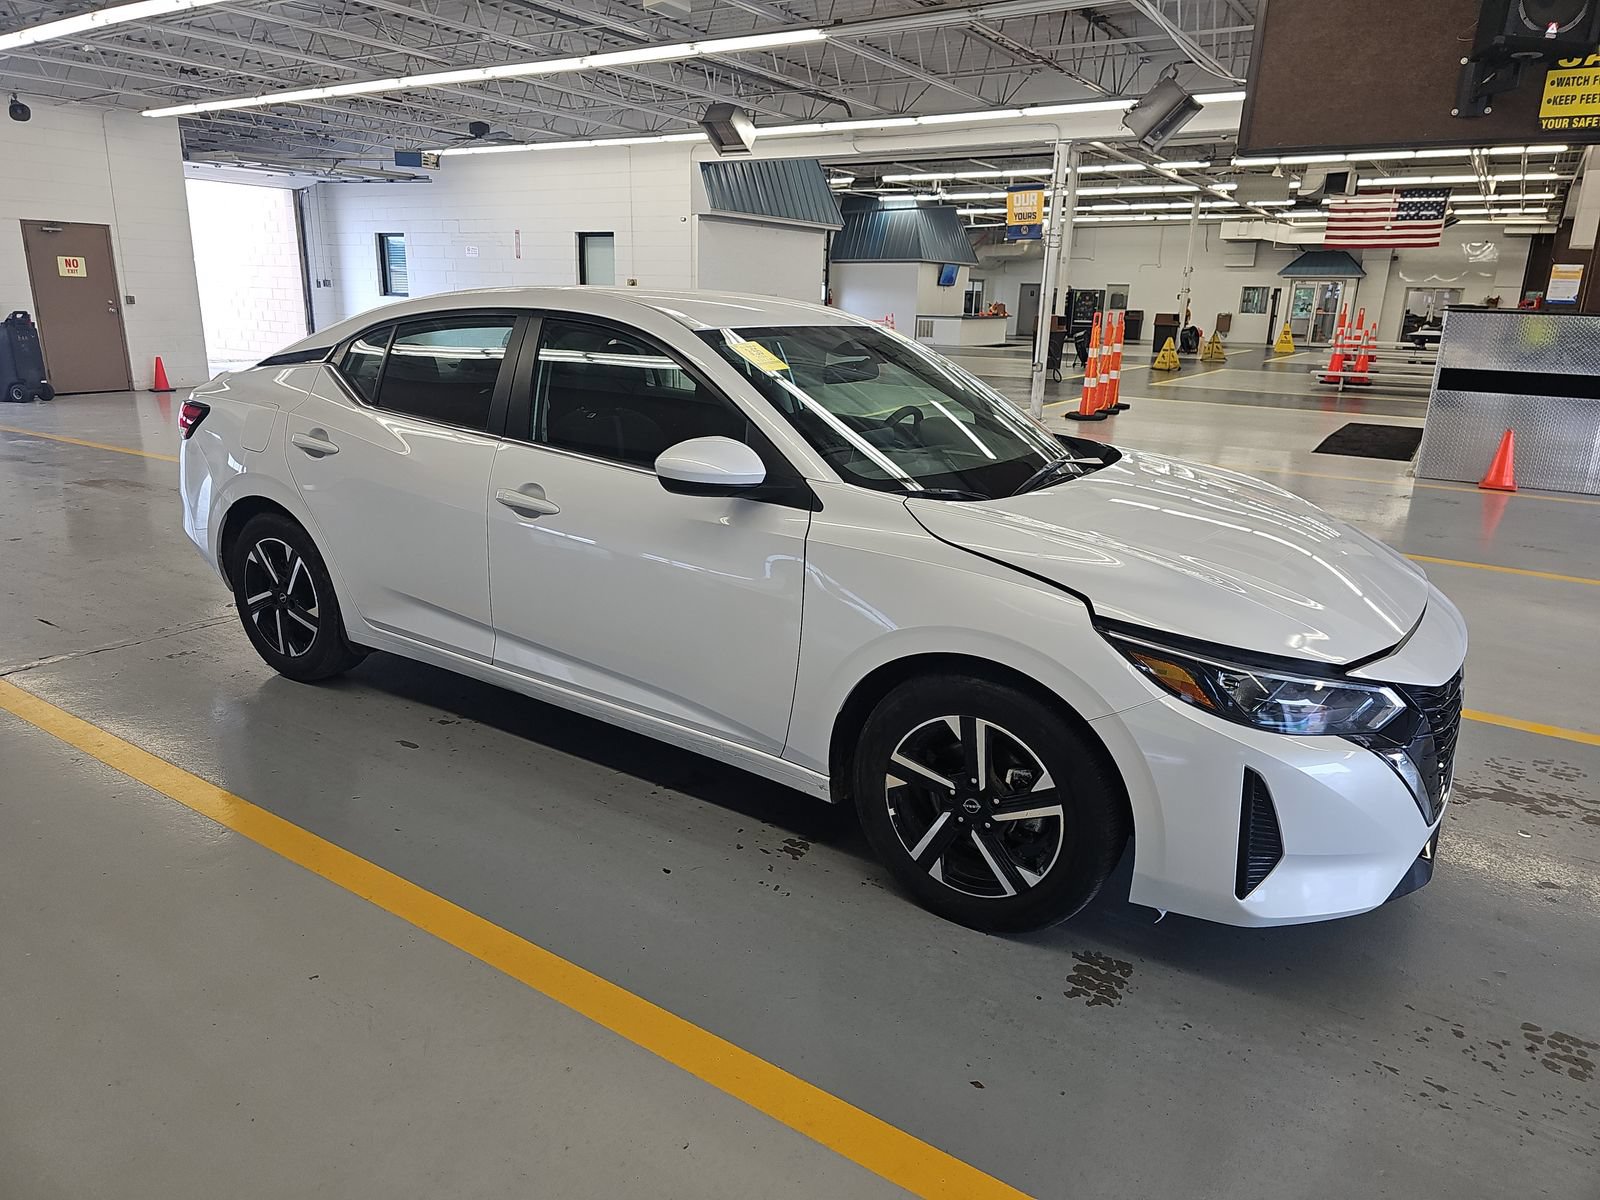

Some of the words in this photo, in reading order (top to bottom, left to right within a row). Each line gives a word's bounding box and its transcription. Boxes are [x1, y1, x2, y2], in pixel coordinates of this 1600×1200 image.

[1556, 76, 1590, 87] WATCH
[1552, 94, 1577, 105] KEEP
[1542, 119, 1569, 129] YOUR
[1572, 117, 1600, 127] SAFE
[1013, 212, 1037, 220] YOURS
[64, 258, 79, 268] NO
